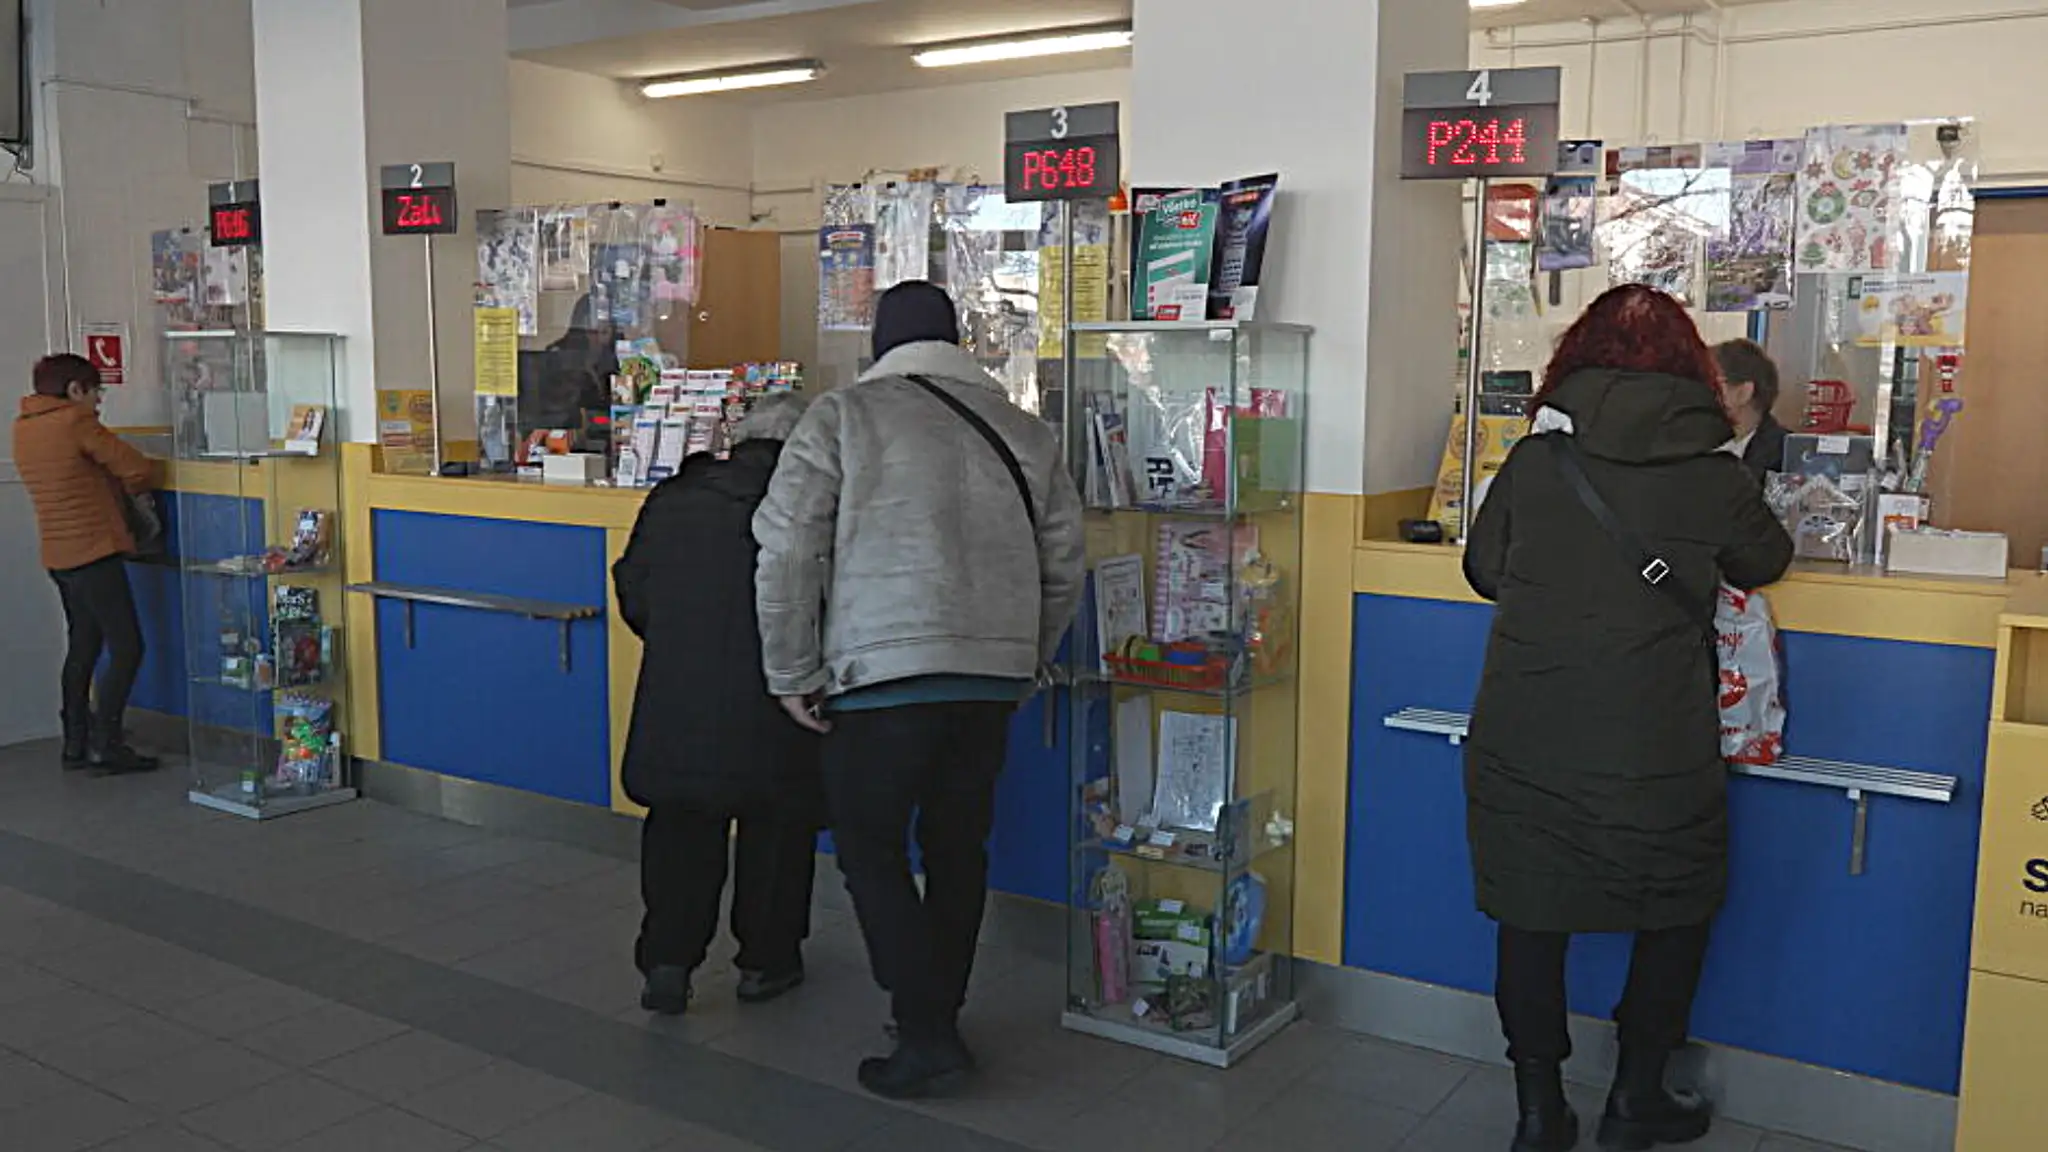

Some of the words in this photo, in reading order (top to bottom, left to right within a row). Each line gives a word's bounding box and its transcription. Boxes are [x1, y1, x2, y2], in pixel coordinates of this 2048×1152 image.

[1466, 70, 1492, 106] 4
[1050, 107, 1068, 139] 3
[1427, 118, 1526, 165] P244
[410, 164, 423, 188] 2
[1022, 146, 1095, 191] P648
[228, 181, 236, 204] 1
